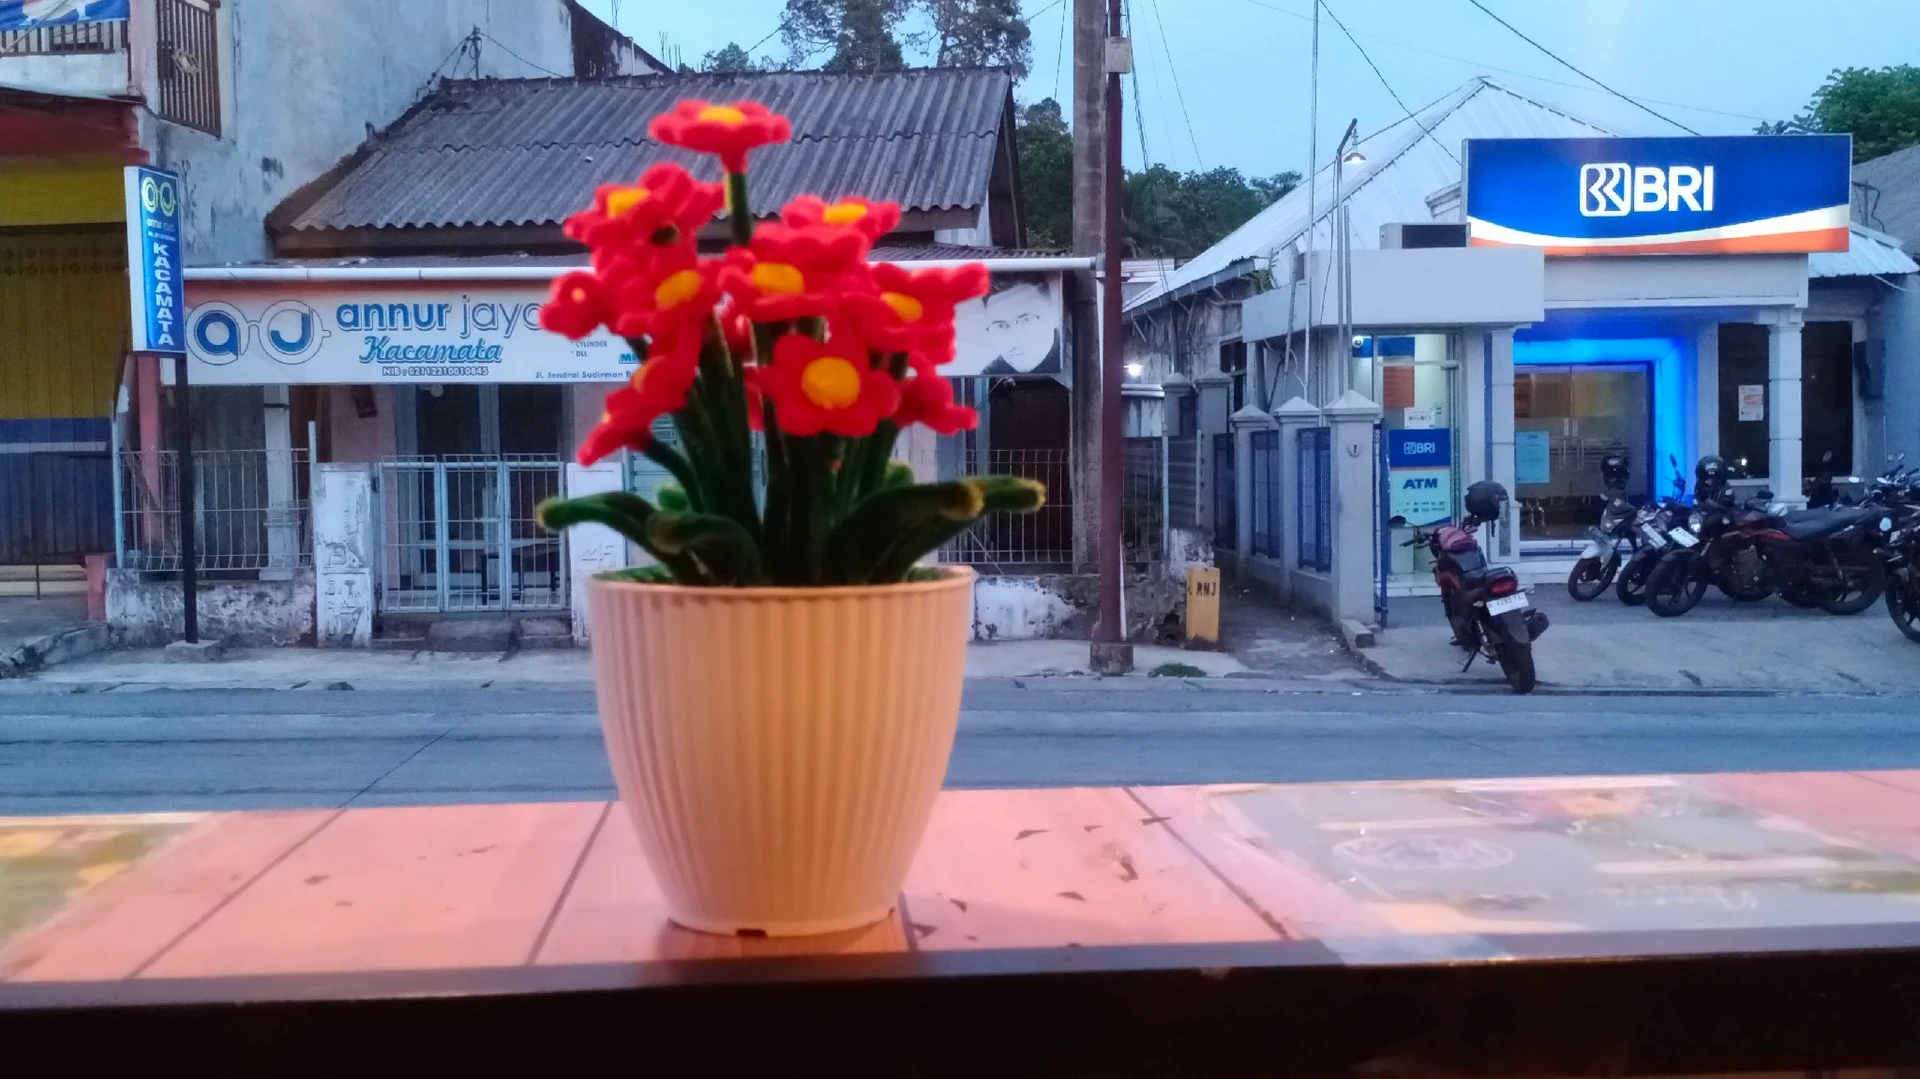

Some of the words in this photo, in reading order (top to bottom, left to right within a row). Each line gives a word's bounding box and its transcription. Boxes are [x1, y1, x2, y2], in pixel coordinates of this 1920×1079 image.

[1634, 165, 1714, 212] BRI
[153, 242, 174, 346] KACAMATA
[336, 303, 451, 331] annur
[359, 335, 502, 364] Kacamata
[547, 371, 580, 379] Jendral
[582, 370, 623, 378] Sudirman
[1416, 442, 1436, 453] BRI
[1403, 478, 1438, 490] ATM
